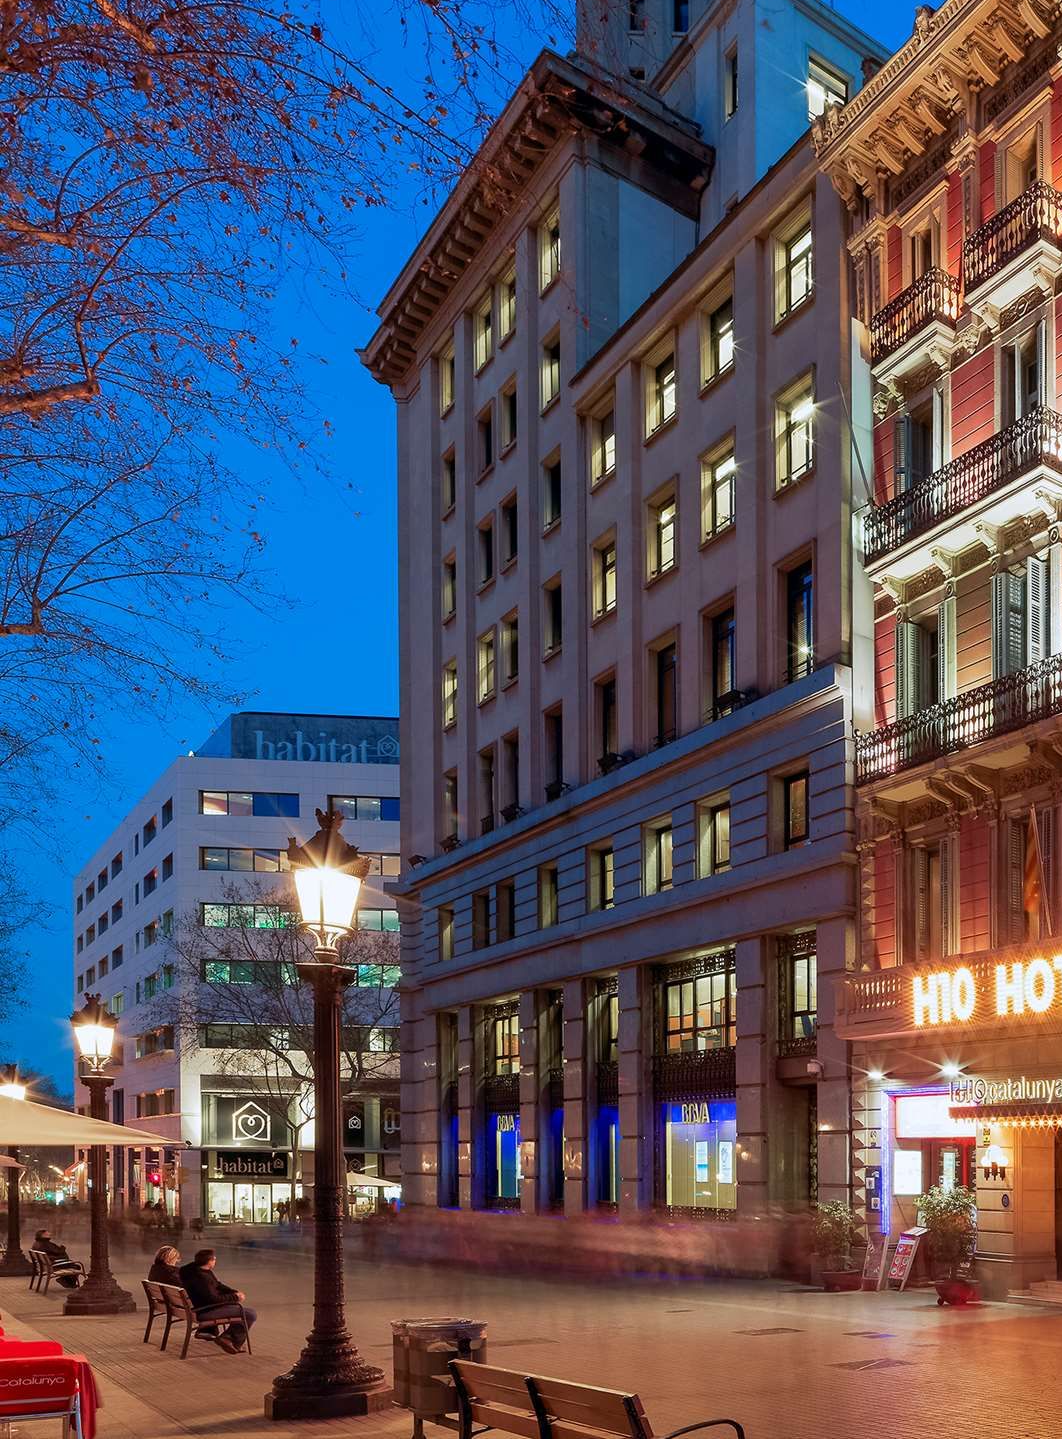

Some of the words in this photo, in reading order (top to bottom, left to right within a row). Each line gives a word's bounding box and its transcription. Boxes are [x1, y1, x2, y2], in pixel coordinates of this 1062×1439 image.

[253, 730, 373, 763] habitat
[912, 966, 976, 1026] H10
[682, 1102, 710, 1124] BBVA
[218, 1157, 273, 1173] habitat
